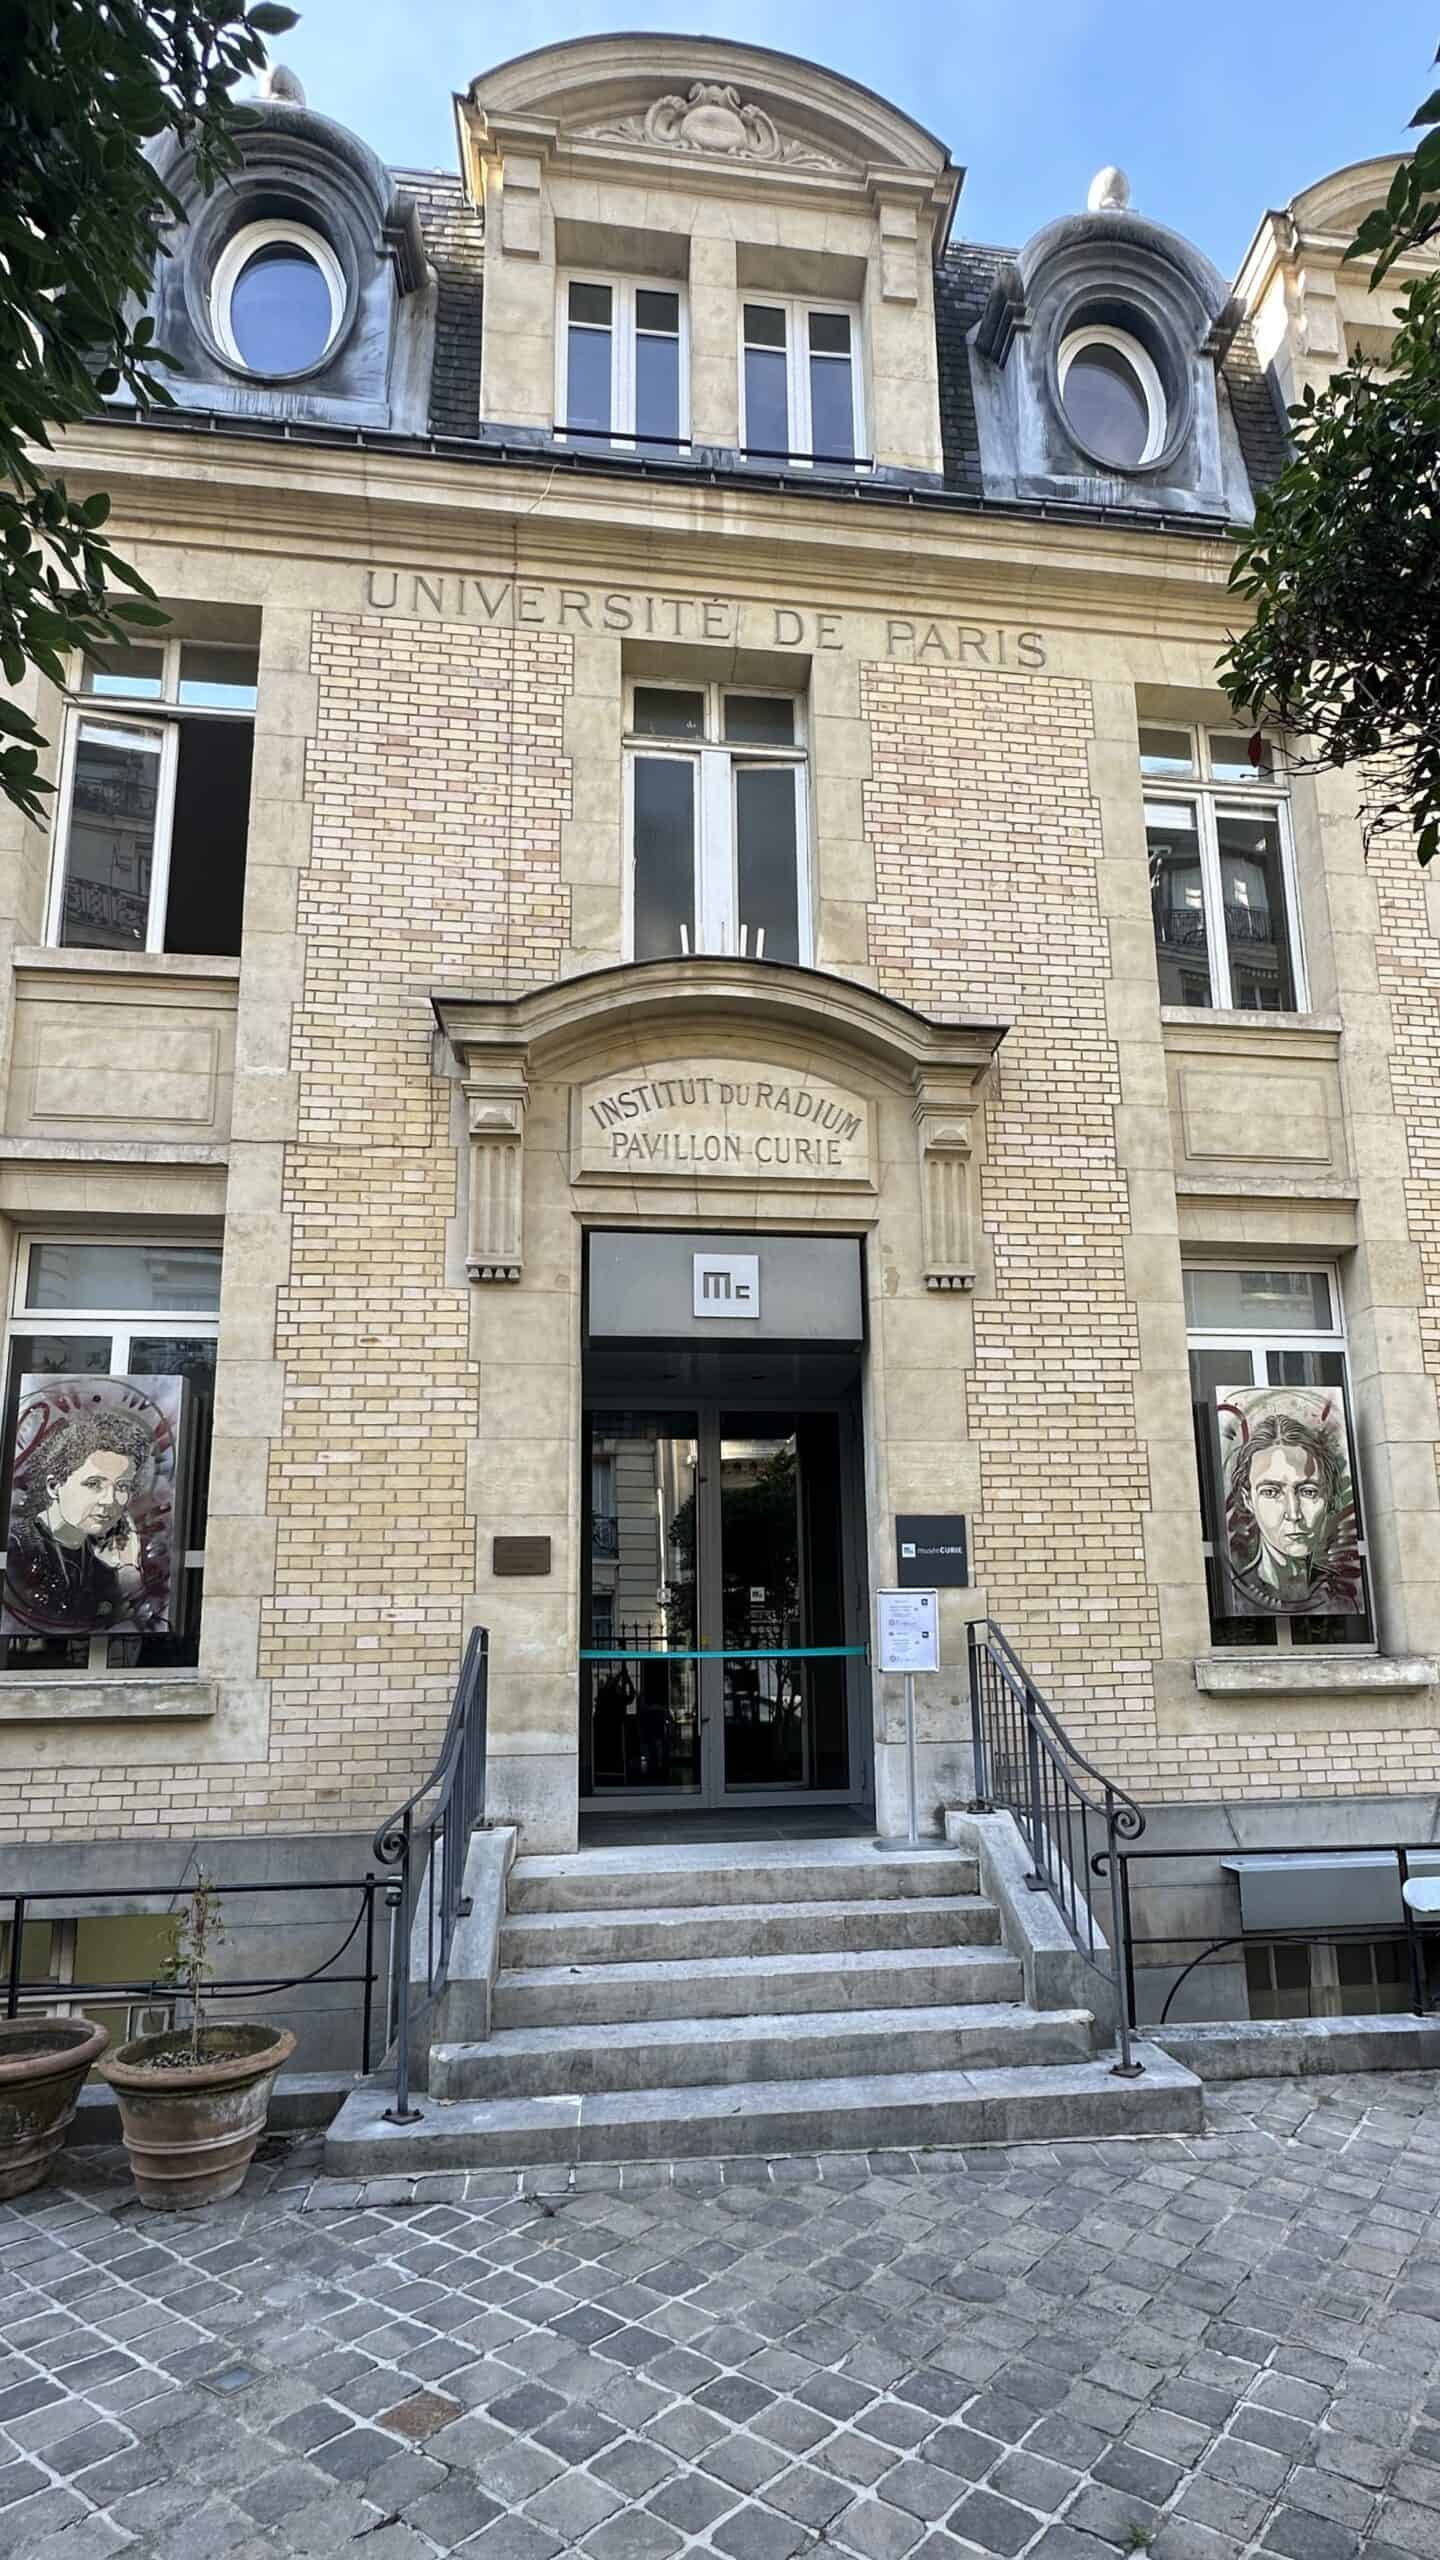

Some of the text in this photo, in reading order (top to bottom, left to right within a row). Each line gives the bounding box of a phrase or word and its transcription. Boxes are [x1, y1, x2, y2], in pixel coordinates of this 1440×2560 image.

[366, 570, 1047, 669] UNIVERSITÉ DE PARIS
[588, 1077, 864, 1142] INSTITUT DU RADIUM
[611, 1131, 843, 1166] PAVILLON CURIE
